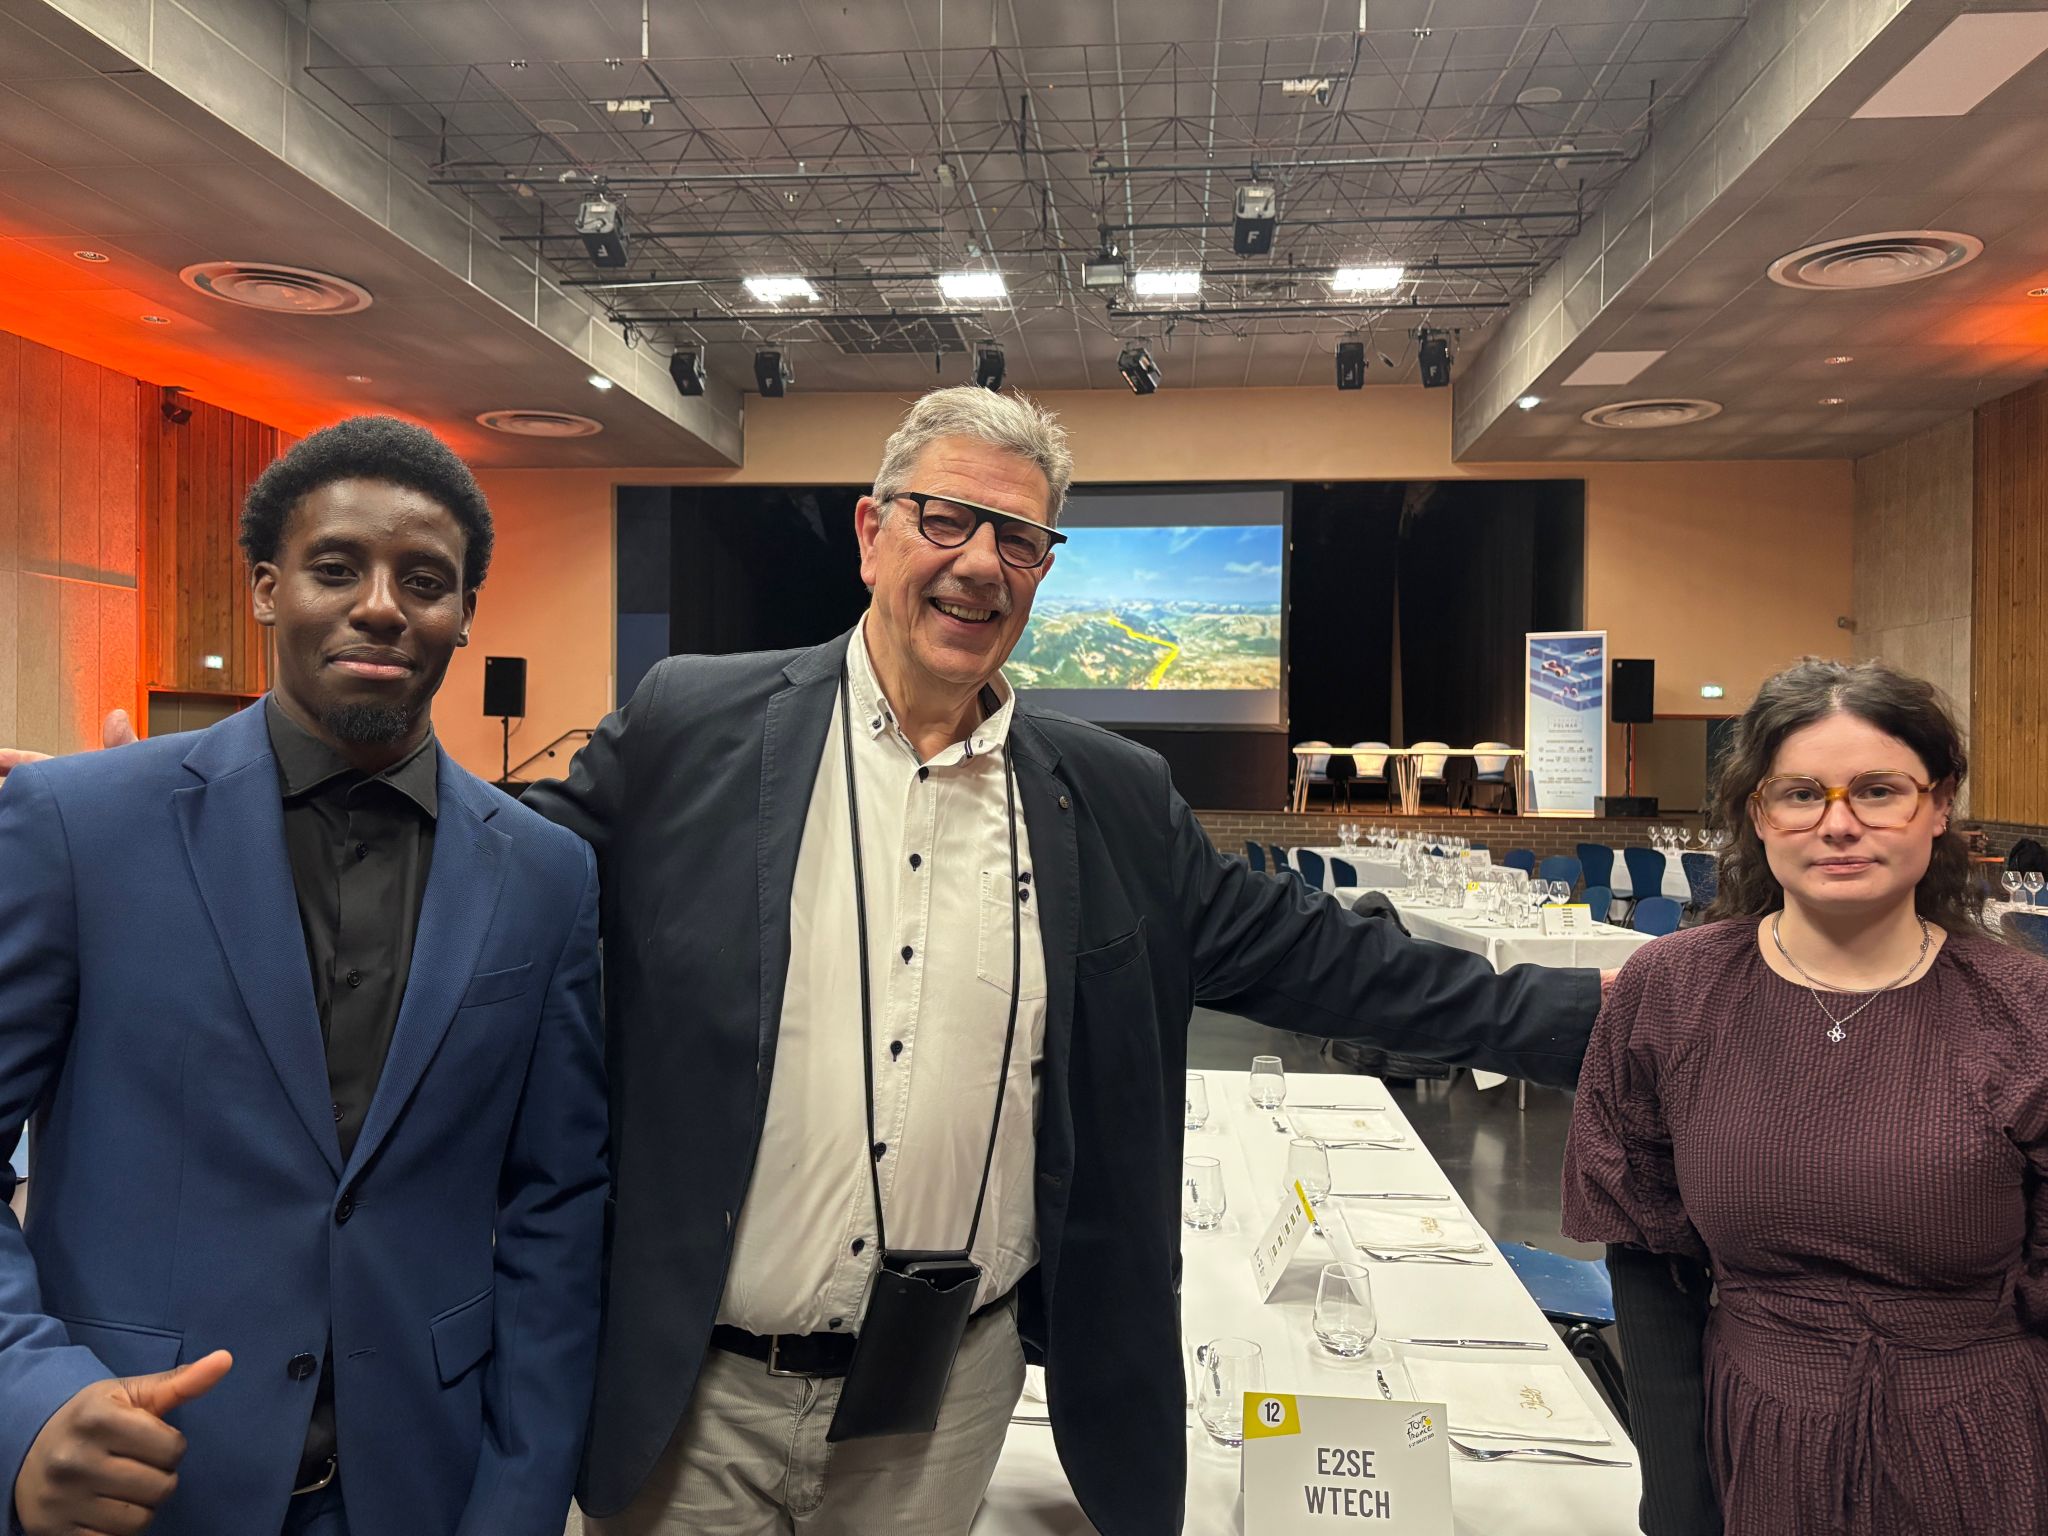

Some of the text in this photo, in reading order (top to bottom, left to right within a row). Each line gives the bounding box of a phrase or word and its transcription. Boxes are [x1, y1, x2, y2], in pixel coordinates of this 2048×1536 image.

[1247, 231, 1260, 244] F
[1265, 1402, 1280, 1422] 12
[1317, 1447, 1376, 1478] E2SE
[1304, 1485, 1390, 1519] WTECH
